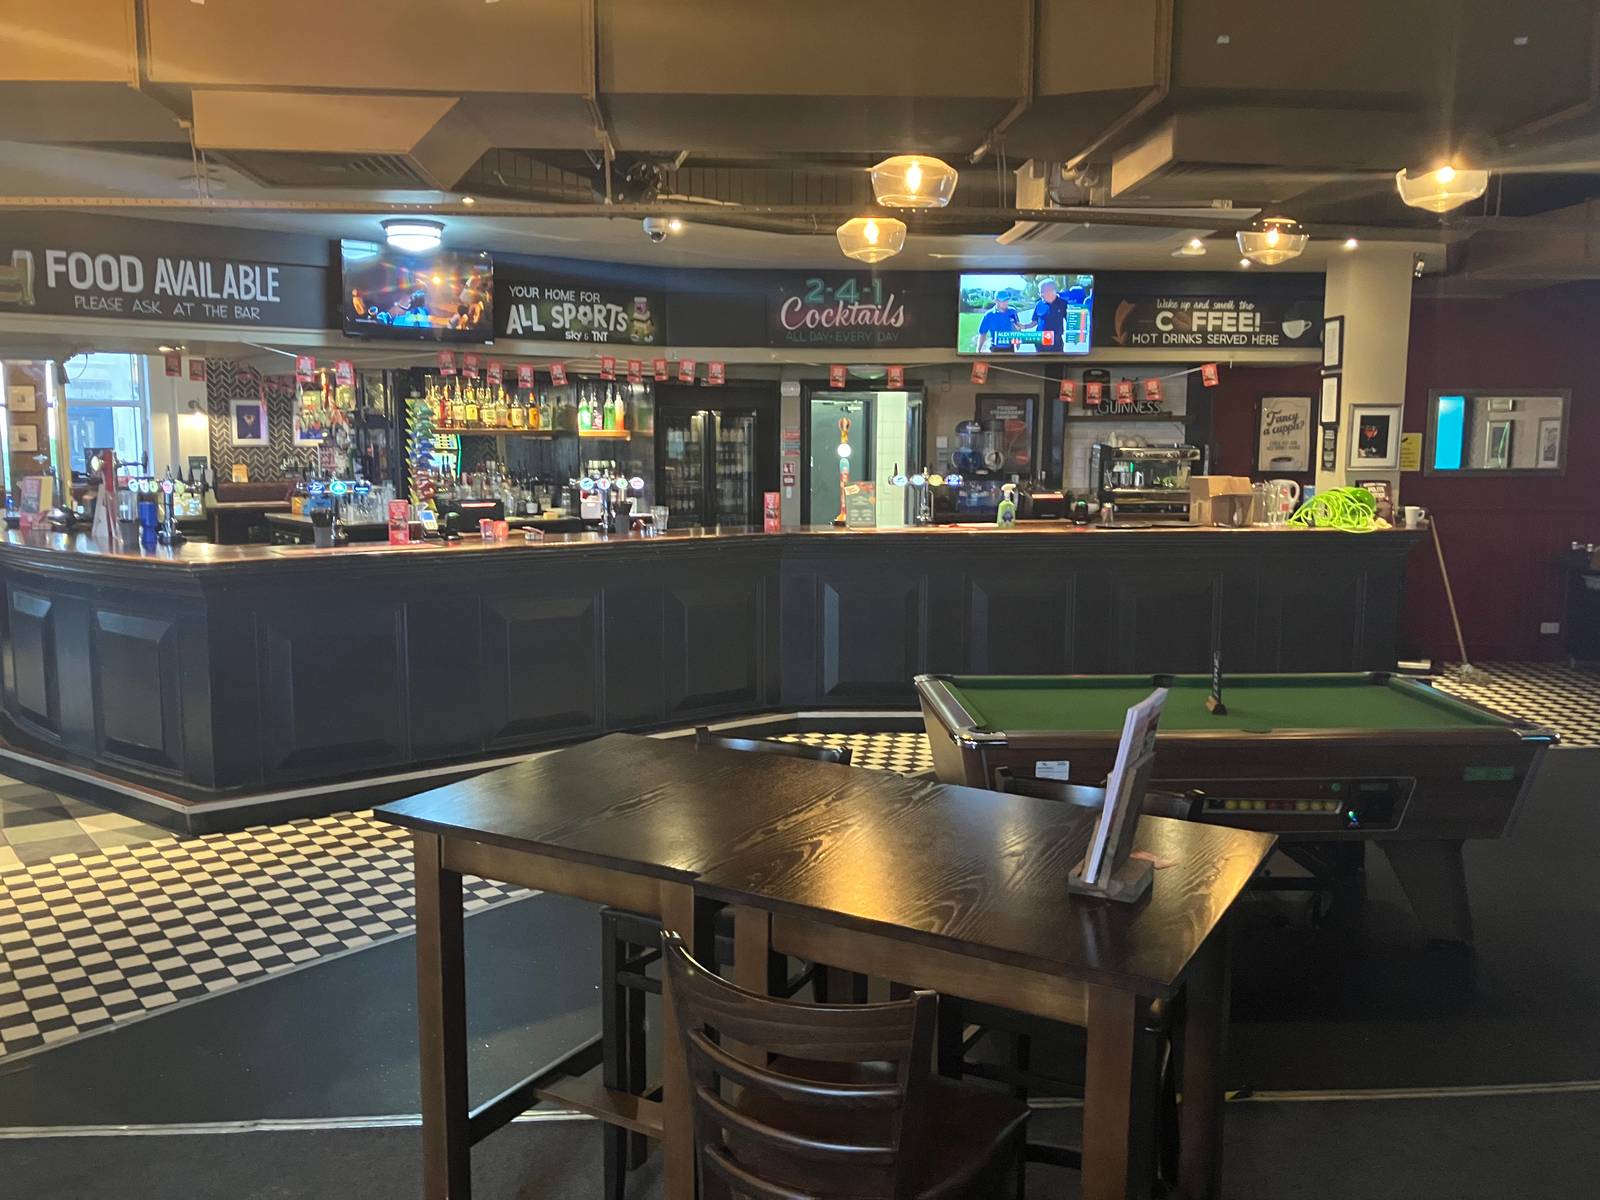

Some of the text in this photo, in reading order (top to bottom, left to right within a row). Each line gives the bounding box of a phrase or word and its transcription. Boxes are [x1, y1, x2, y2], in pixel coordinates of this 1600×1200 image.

[46, 249, 281, 302] FOOD AVAILABLE
[509, 285, 600, 303] YOUR HOME FOR
[804, 277, 884, 304] 2-4-1
[74, 295, 260, 320] PLEASE ASK AT THE BAR
[780, 294, 905, 330] Cocktails
[1157, 299, 1178, 310] Wake
[1180, 301, 1191, 312] up
[1213, 299, 1235, 310] smell
[1239, 300, 1255, 310] the
[506, 302, 628, 335] ALL SPORTS
[565, 331, 582, 342] sky
[592, 331, 609, 342] TNT
[785, 331, 807, 342] ALL
[878, 331, 899, 342] DAY
[1132, 333, 1279, 345] HOT DRINKS SERVED HERE
[1098, 399, 1161, 414] GUINNESS
[1266, 410, 1299, 426] Fancy
[1263, 428, 1271, 436] a
